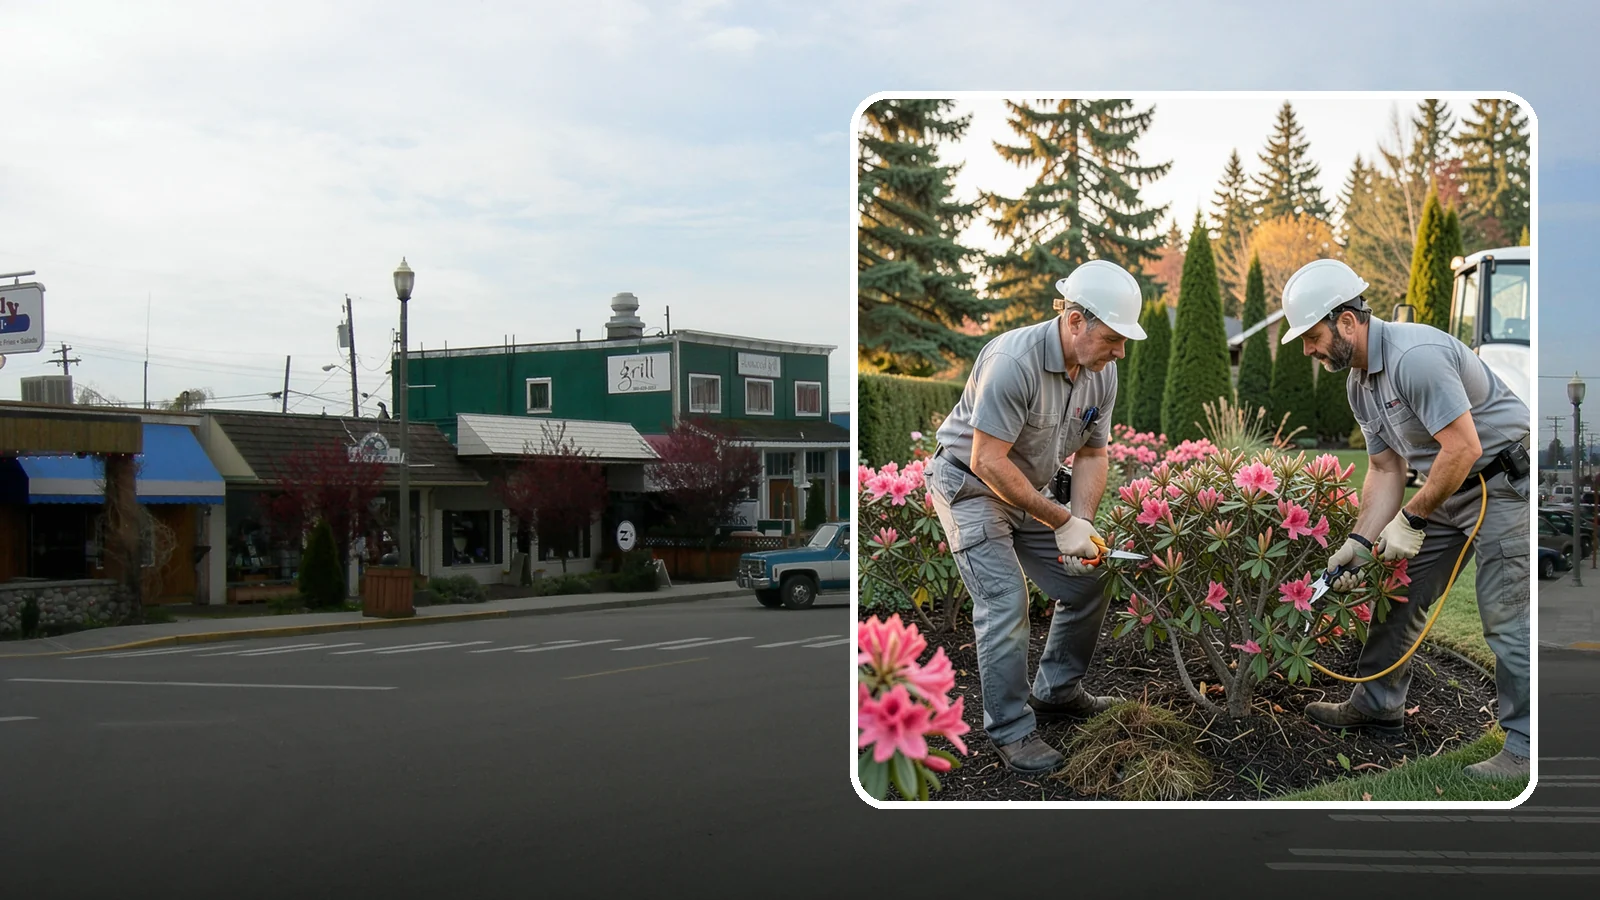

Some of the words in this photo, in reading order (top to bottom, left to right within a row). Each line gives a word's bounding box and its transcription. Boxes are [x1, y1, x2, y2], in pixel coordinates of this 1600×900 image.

[3, 338, 16, 346] Fries
[20, 336, 38, 345] Salads
[617, 355, 655, 392] grill
